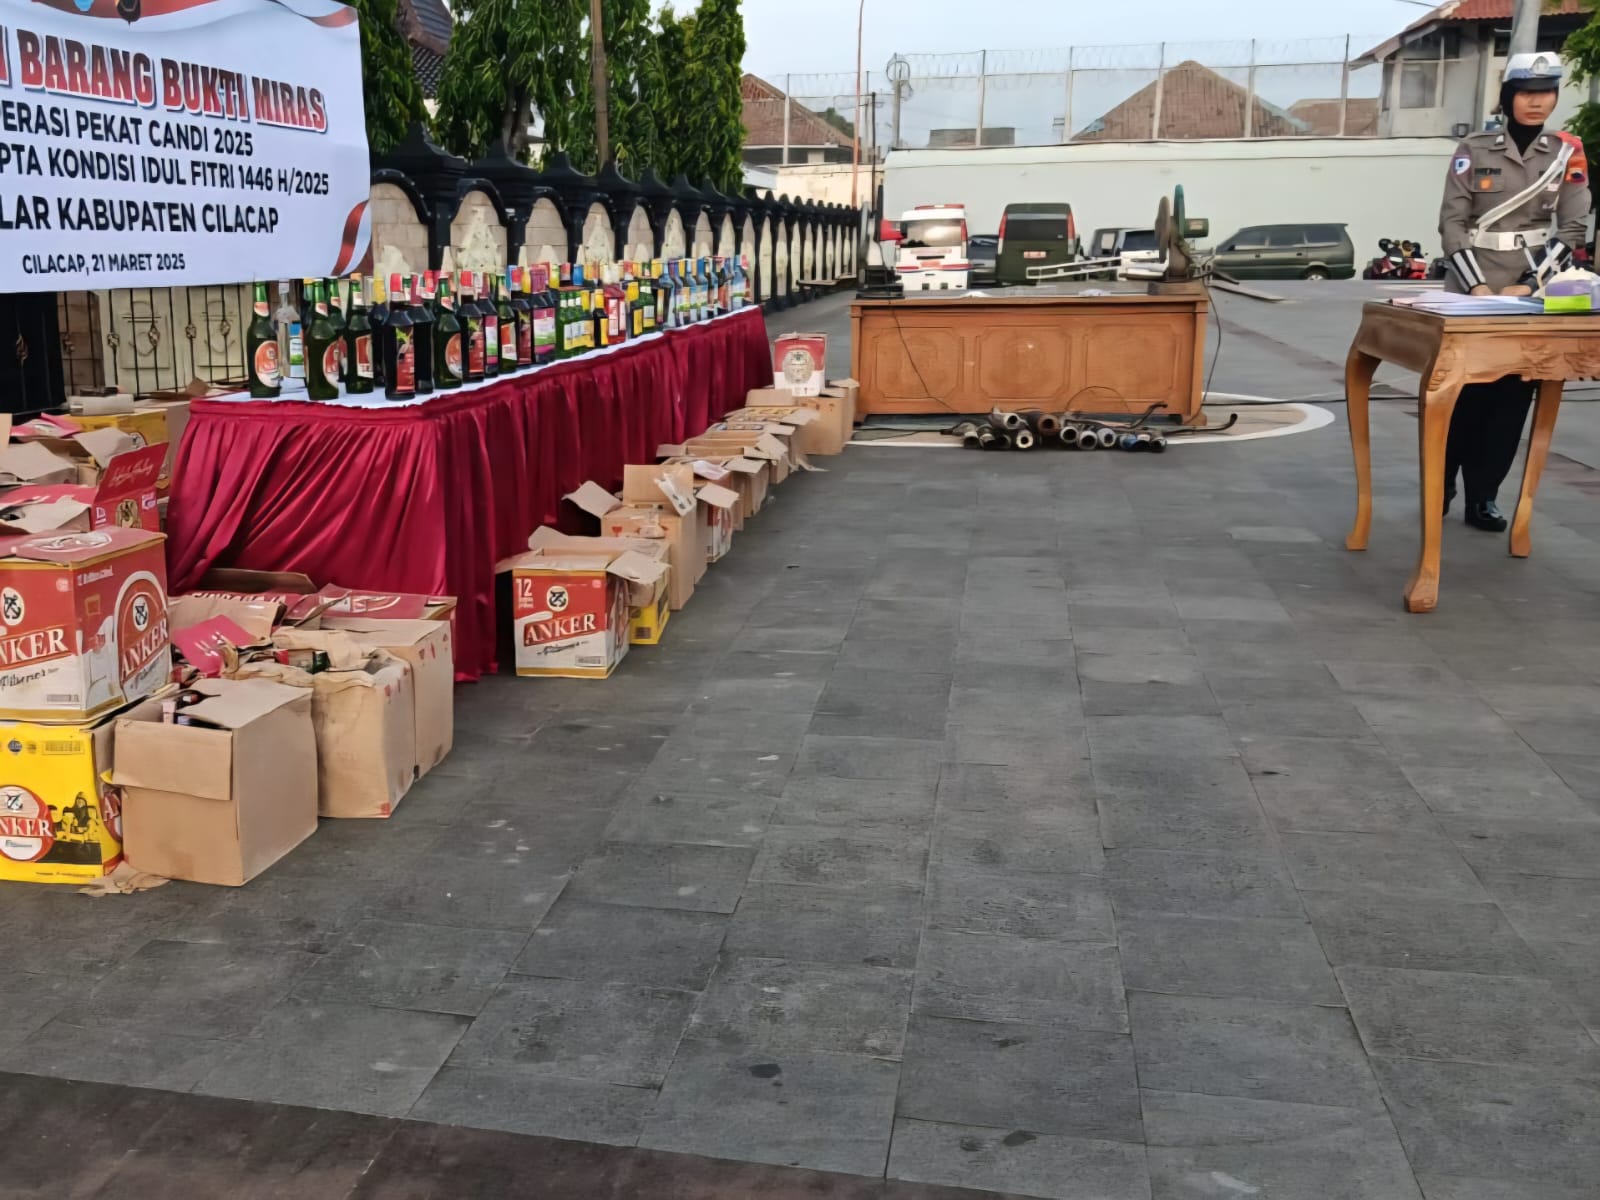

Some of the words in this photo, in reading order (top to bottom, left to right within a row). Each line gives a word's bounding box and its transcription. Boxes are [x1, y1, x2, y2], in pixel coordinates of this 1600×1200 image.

[17, 29, 156, 107] BARANG
[161, 58, 249, 121] BUKTI
[252, 76, 327, 133] MIRAS
[0, 100, 70, 138] ERASI
[76, 110, 142, 145] PEKAT
[149, 120, 208, 152] CANDI
[214, 128, 253, 156] 2025
[0, 142, 43, 176] PTA
[48, 147, 136, 182] KONDISI
[141, 156, 186, 185] IDUL
[191, 160, 235, 188] FITRI
[238, 165, 273, 192] 1446
[278, 168, 329, 196] H/2025
[0, 195, 51, 230] LAR
[57, 197, 196, 232] KABUPATEN
[202, 204, 279, 233] CILACAP
[22, 254, 90, 276] CILACAP,
[92, 254, 105, 272] 21
[108, 253, 152, 271] MARET
[157, 253, 185, 270] 2025
[121, 617, 168, 682] ANKER
[525, 613, 596, 646] ANKER
